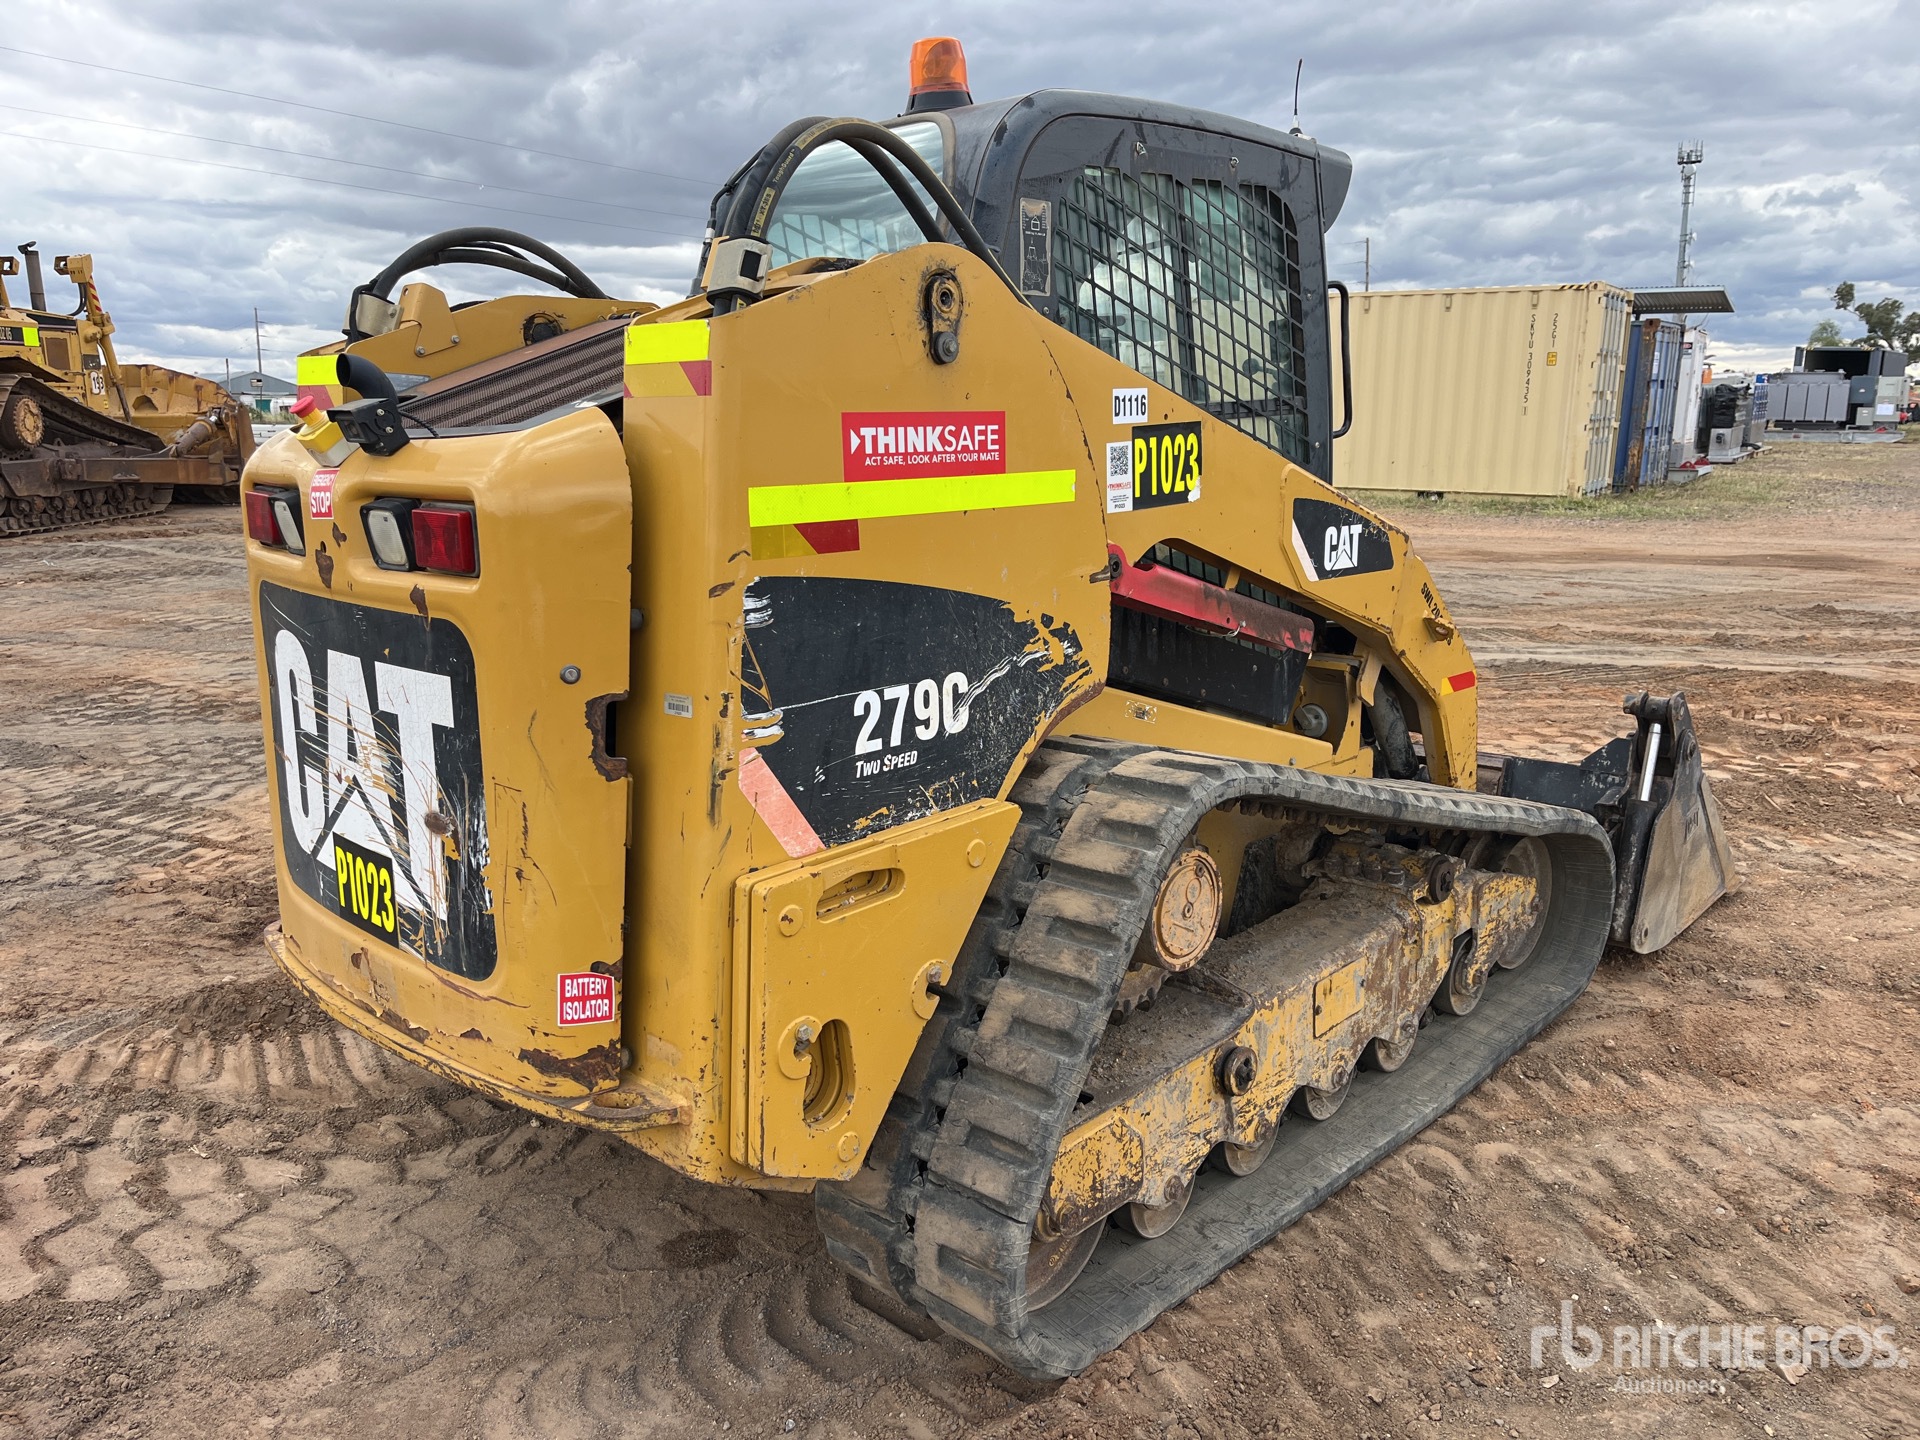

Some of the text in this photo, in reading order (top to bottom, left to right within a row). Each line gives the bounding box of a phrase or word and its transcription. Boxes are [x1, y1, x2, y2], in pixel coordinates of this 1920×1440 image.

[1528, 314, 1536, 349] SKYU
[1551, 313, 1559, 348] 25G1
[1523, 352, 1533, 403] 309435
[1114, 394, 1147, 417] D1116
[860, 424, 1000, 454] THINKSAFE
[864, 451, 1000, 466] ACT SAFE, LOOK AFTER YOUR MATE
[1134, 432, 1200, 498] P1023
[311, 491, 331, 514] STOP
[1323, 524, 1363, 571] CAT
[853, 671, 969, 756] 279C
[275, 629, 455, 922] CAT
[335, 846, 395, 934] P1023
[564, 977, 608, 998] BATTERY
[563, 998, 610, 1021] ISOLATOR
